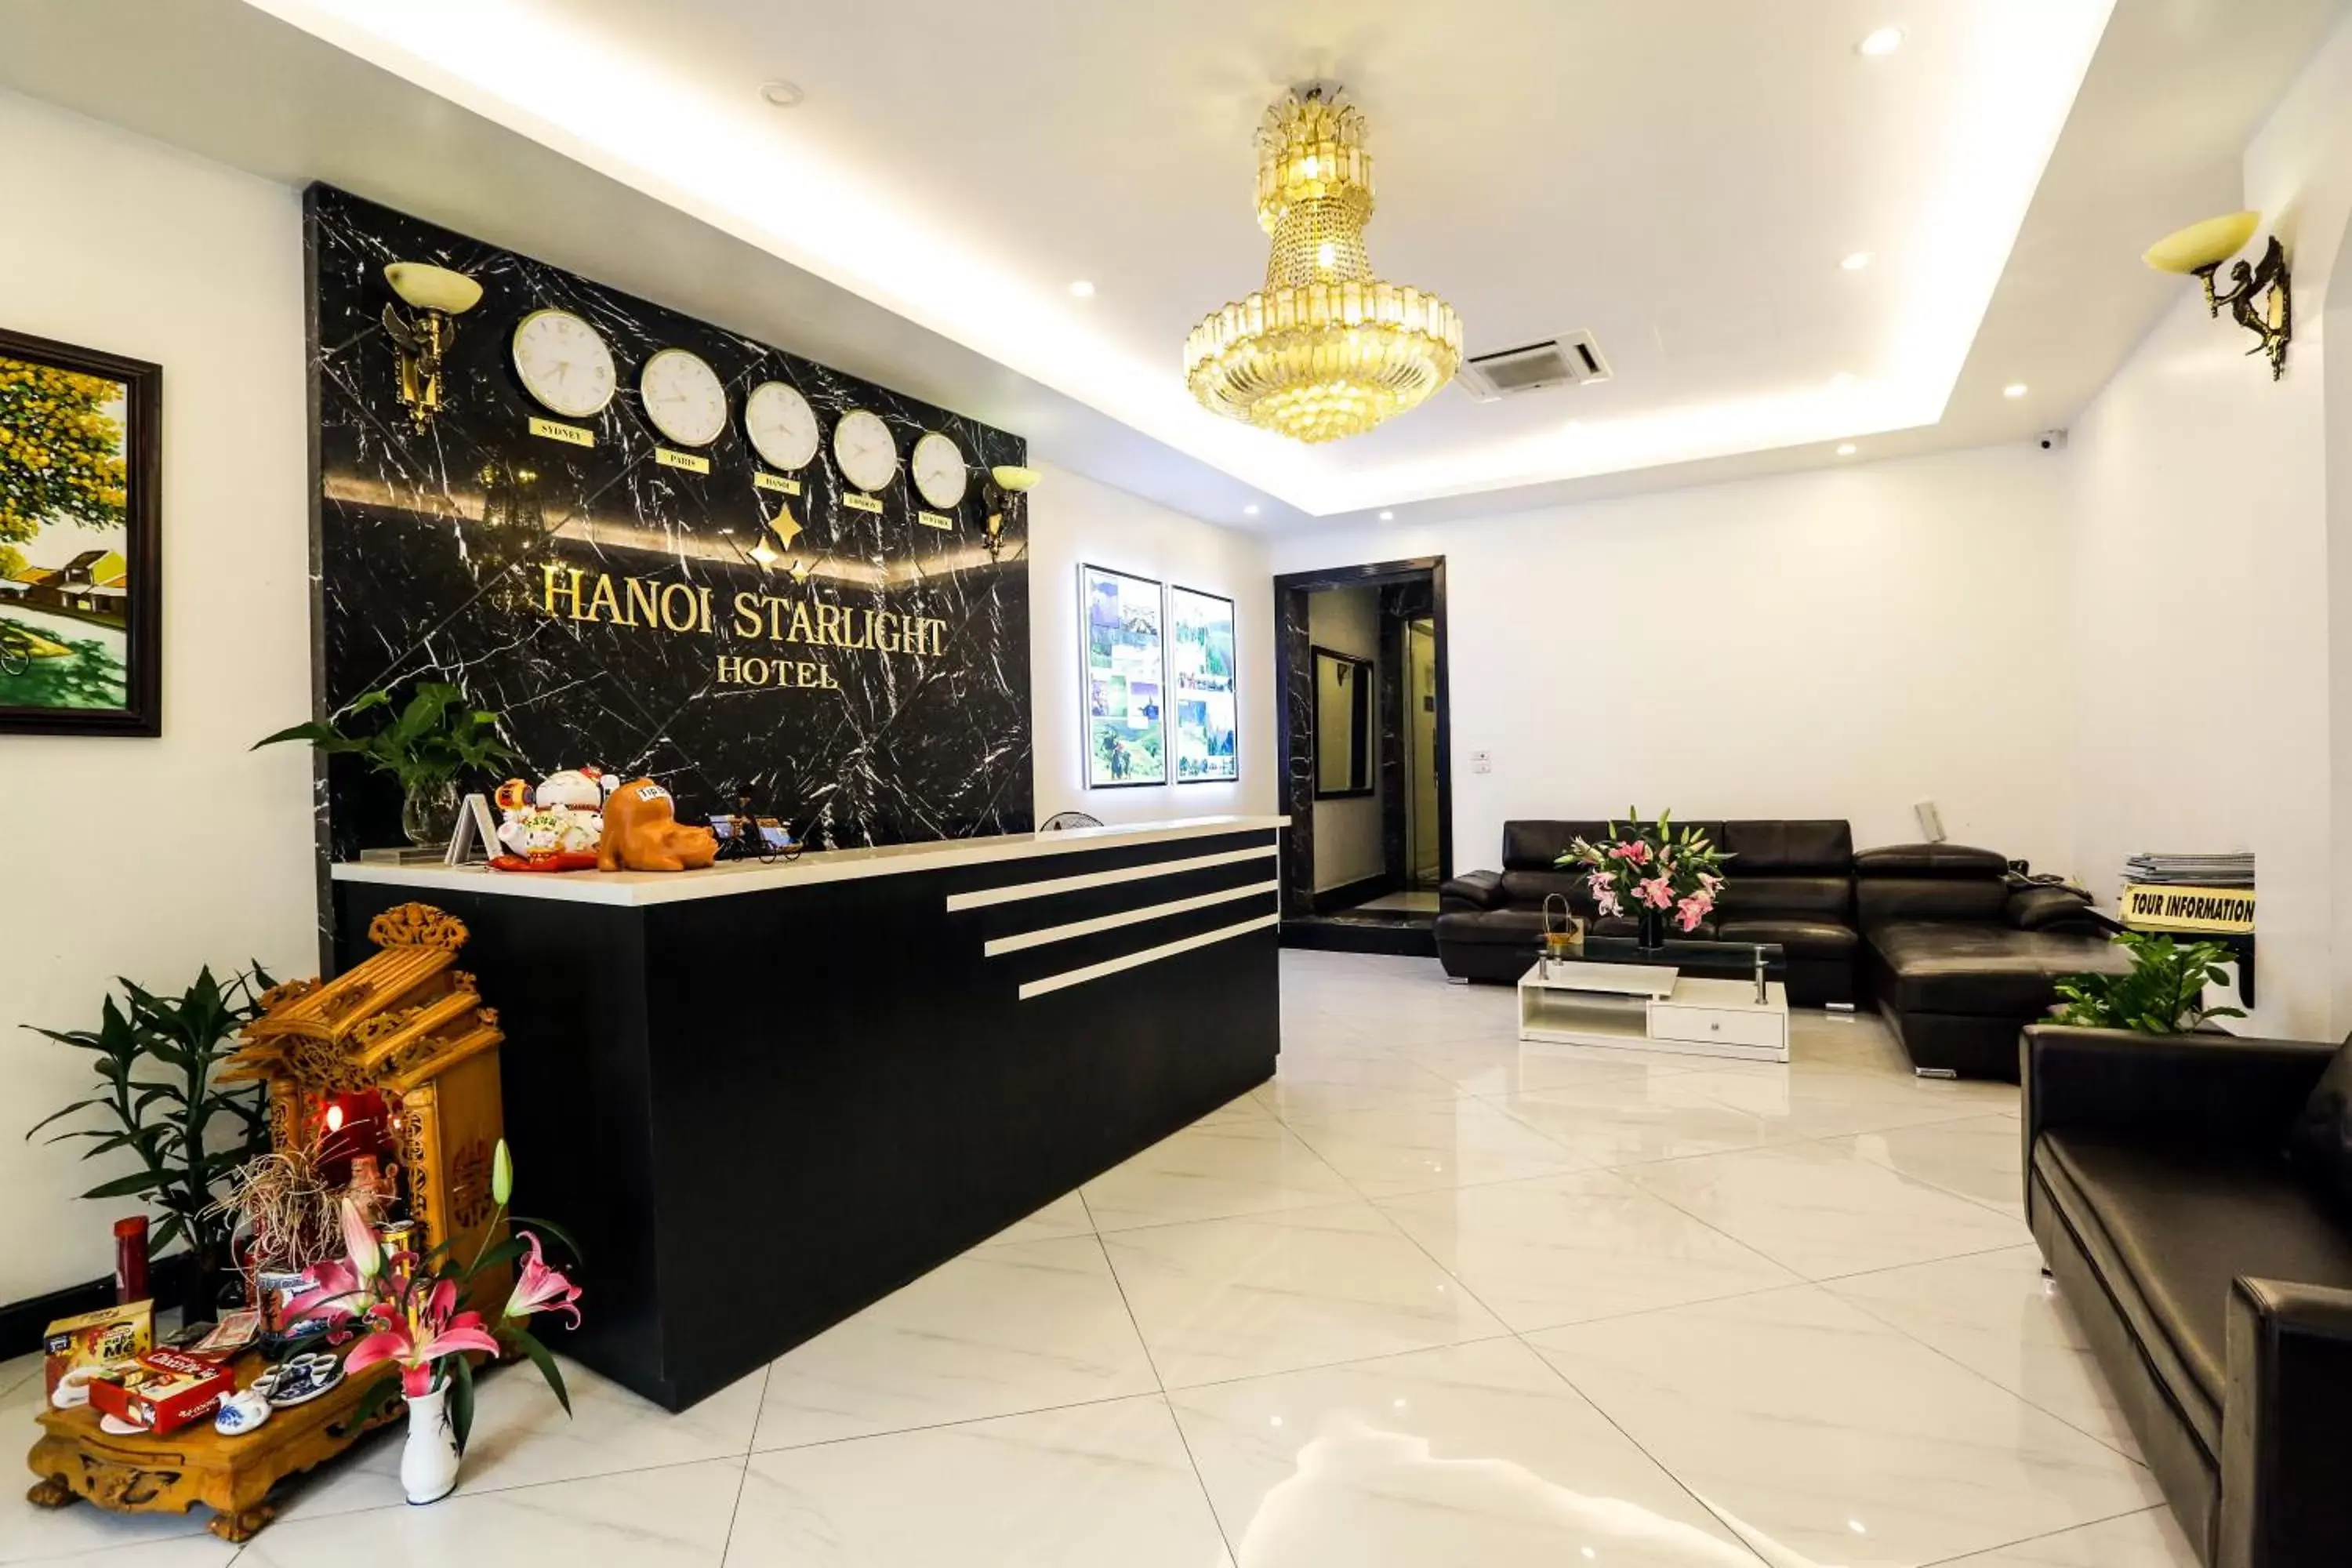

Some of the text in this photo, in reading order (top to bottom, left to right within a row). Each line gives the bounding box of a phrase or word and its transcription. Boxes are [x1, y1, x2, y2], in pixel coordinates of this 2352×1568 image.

[541, 425, 582, 441] SYDNEY
[670, 454, 696, 467] PARIS
[539, 562, 947, 657] HANOI STARLIGHT
[717, 655, 839, 689] HOTEL
[2132, 893, 2256, 923] TOUR INFORMATION
